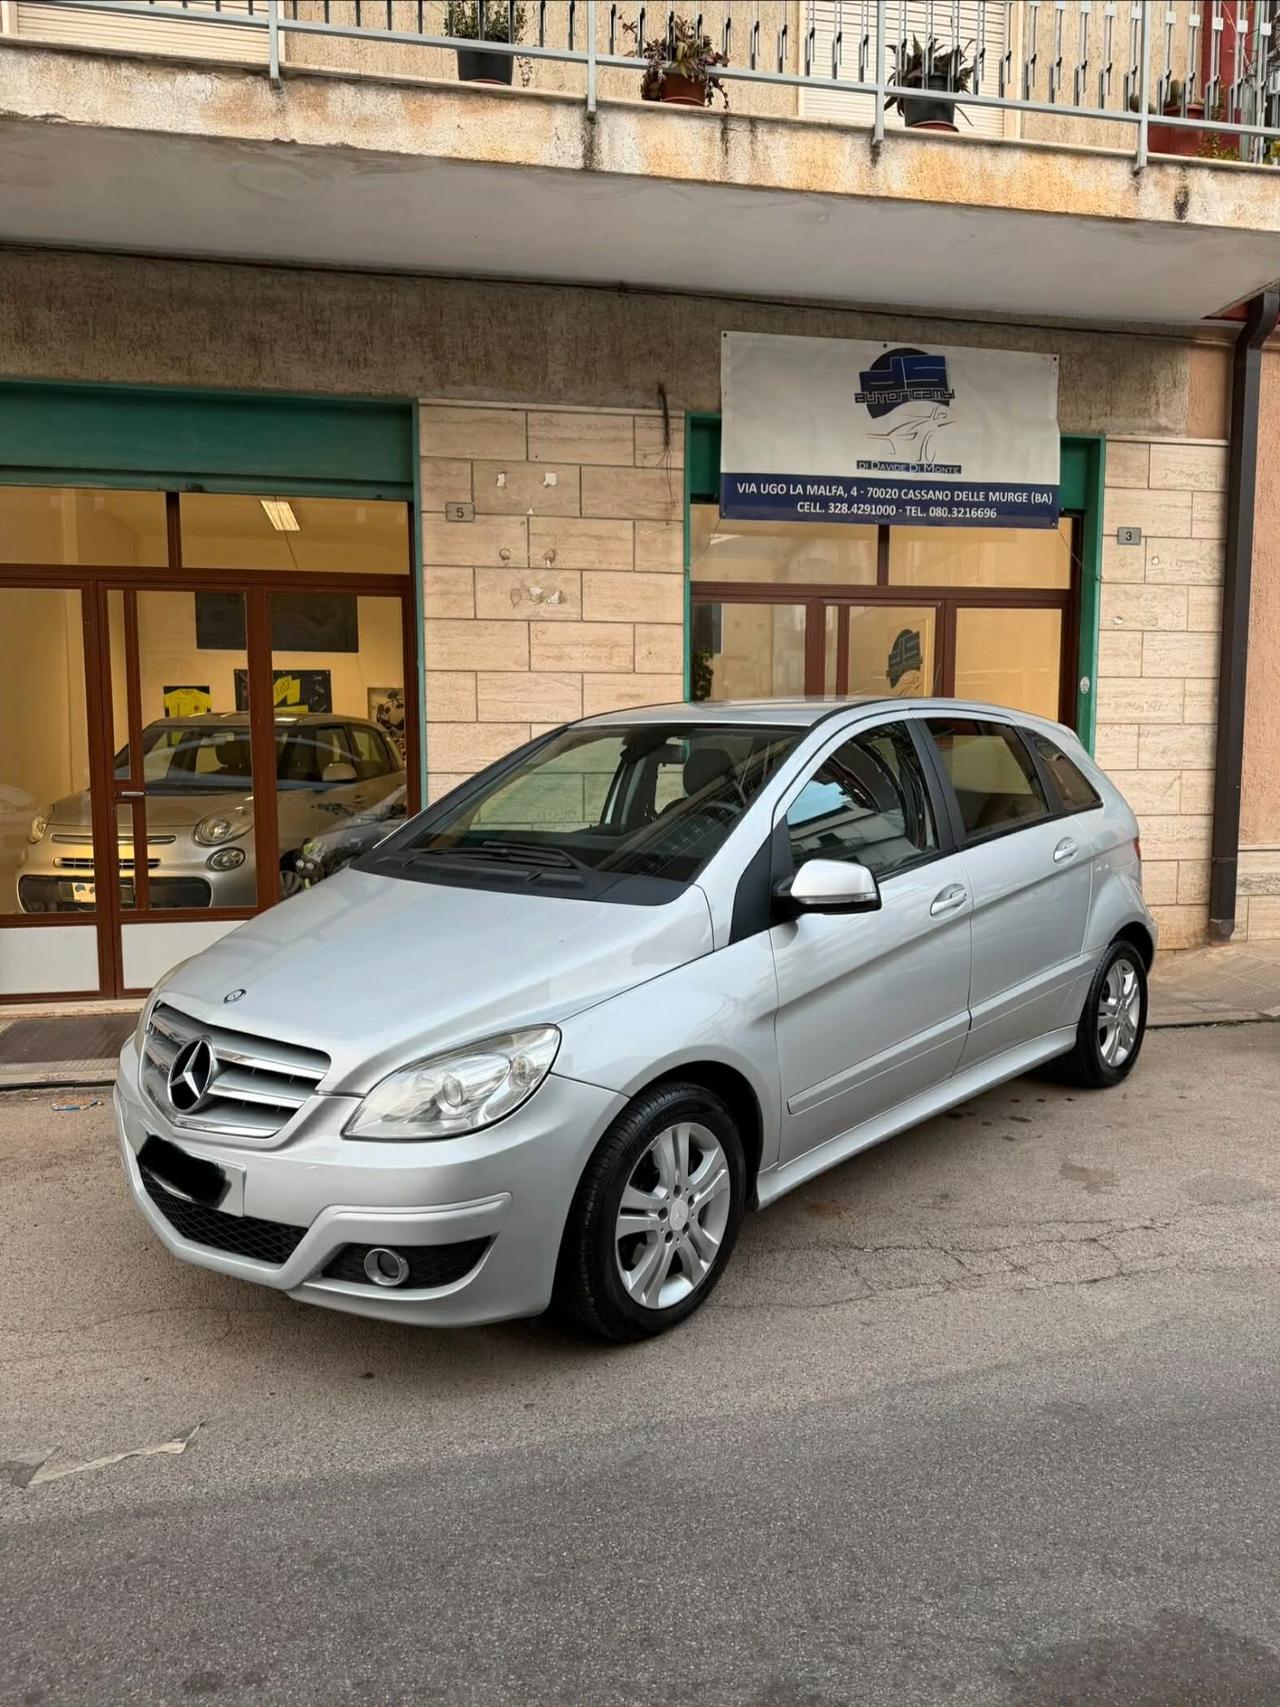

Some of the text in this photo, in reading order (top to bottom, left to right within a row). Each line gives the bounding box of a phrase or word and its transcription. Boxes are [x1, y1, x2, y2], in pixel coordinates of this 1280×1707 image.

[737, 482, 757, 494] VIA
[760, 483, 787, 494] UGO
[789, 484, 804, 495] LA
[806, 485, 848, 498] MALFA,
[850, 486, 857, 497] 4
[867, 487, 899, 499] 70020
[901, 488, 951, 501] CASSANO
[954, 490, 986, 502] DELLE
[988, 491, 1028, 503] MURGE
[1030, 492, 1053, 505] (BA)
[456, 507, 464, 518] 5
[797, 501, 825, 513] CELL.
[828, 502, 896, 516] 328.4291000
[905, 505, 927, 517] TEL.
[929, 506, 997, 519] 080.3216696
[1125, 531, 1132, 541] 3
